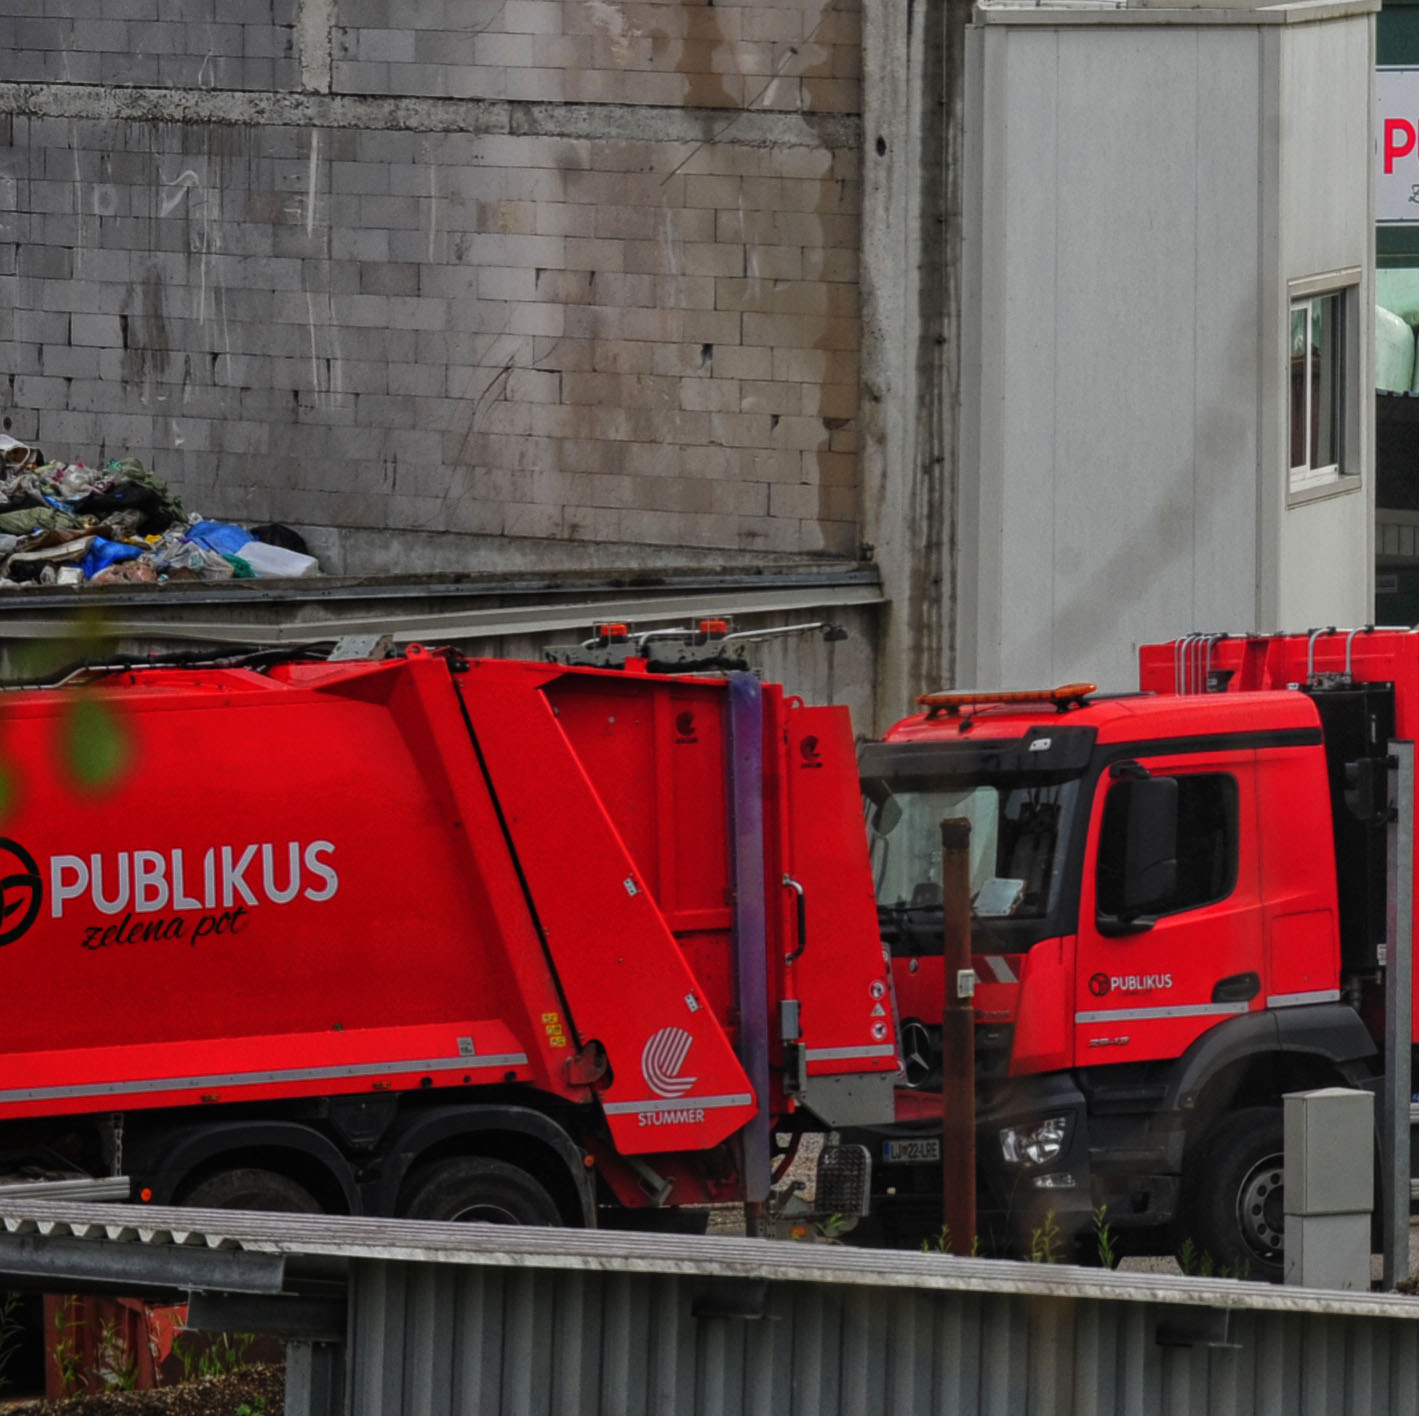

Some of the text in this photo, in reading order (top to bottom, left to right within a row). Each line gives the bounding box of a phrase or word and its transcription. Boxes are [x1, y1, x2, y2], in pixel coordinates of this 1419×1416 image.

[50, 840, 338, 918] PUBLIKUS
[81, 906, 249, 951] zelena pot
[1111, 973, 1174, 991] PUBLIKUS
[638, 1109, 705, 1127] STUMMER
